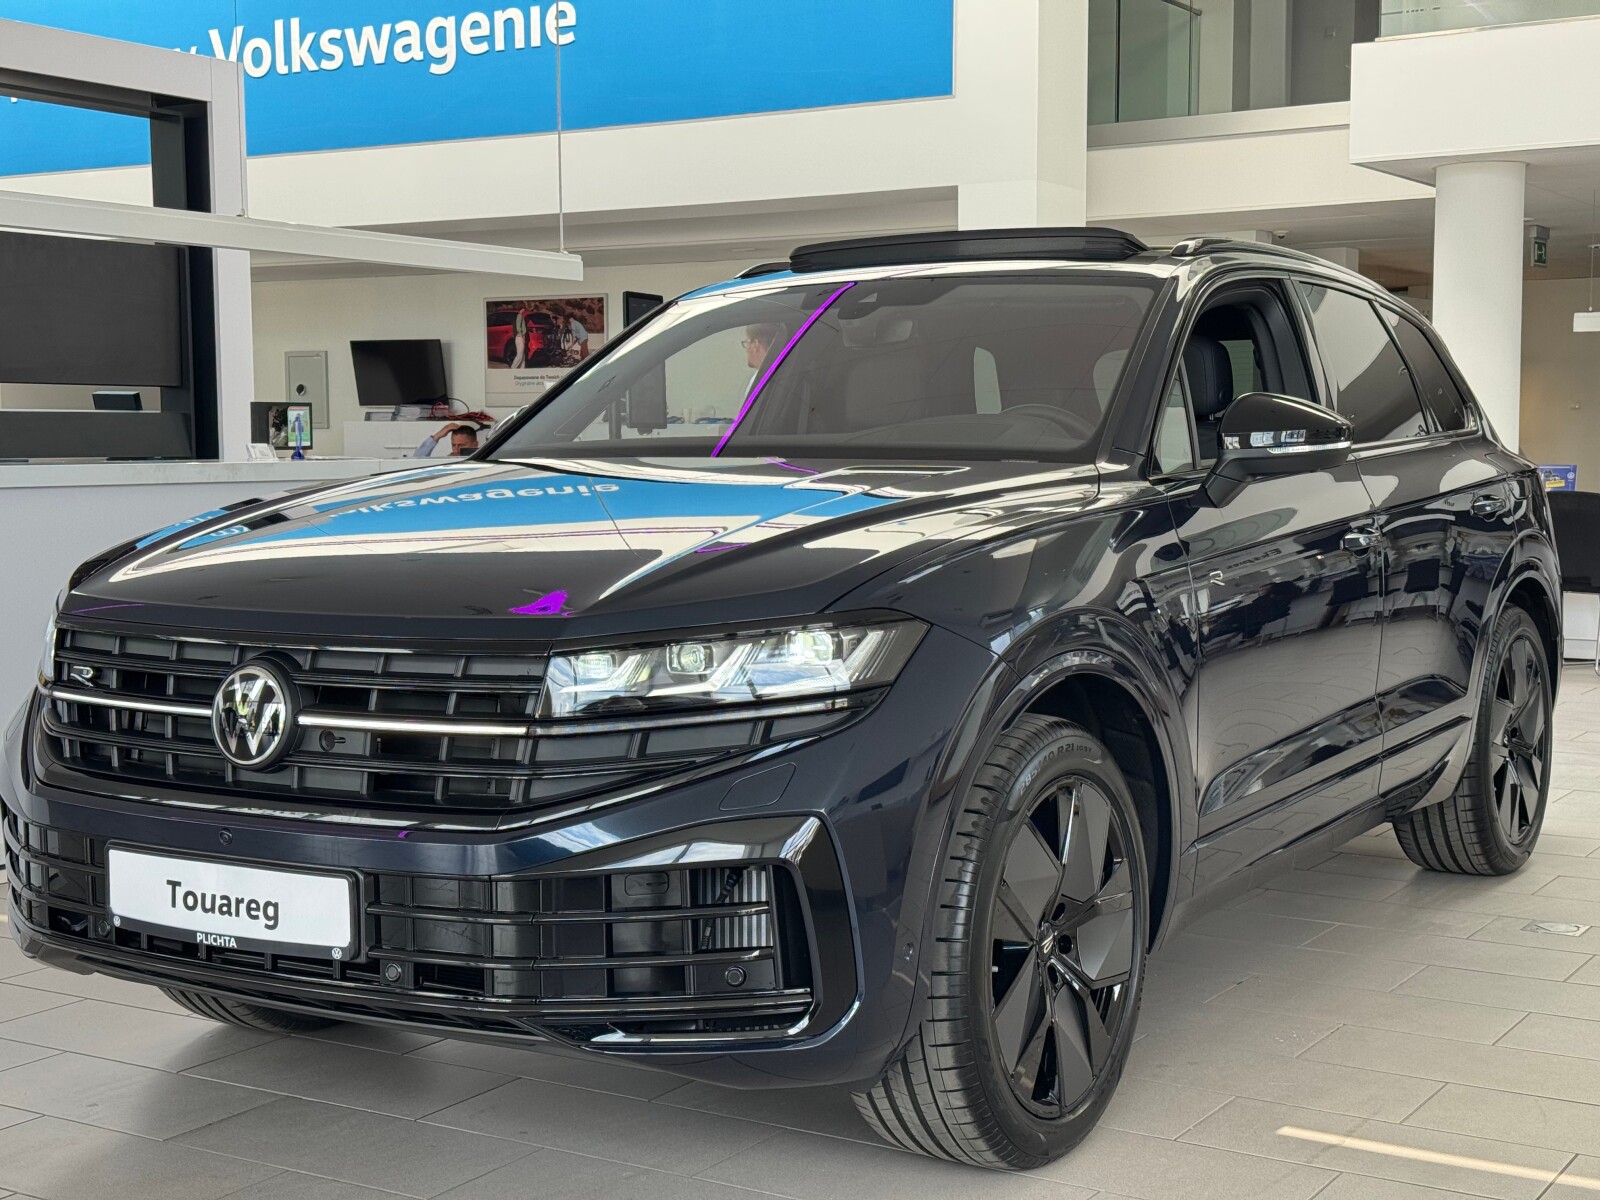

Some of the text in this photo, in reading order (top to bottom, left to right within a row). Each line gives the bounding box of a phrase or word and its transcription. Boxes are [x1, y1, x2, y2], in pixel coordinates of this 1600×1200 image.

[208, 0, 577, 78] Volkswagenie
[166, 879, 279, 931] Touareg
[196, 932, 238, 948] PLICHTA
